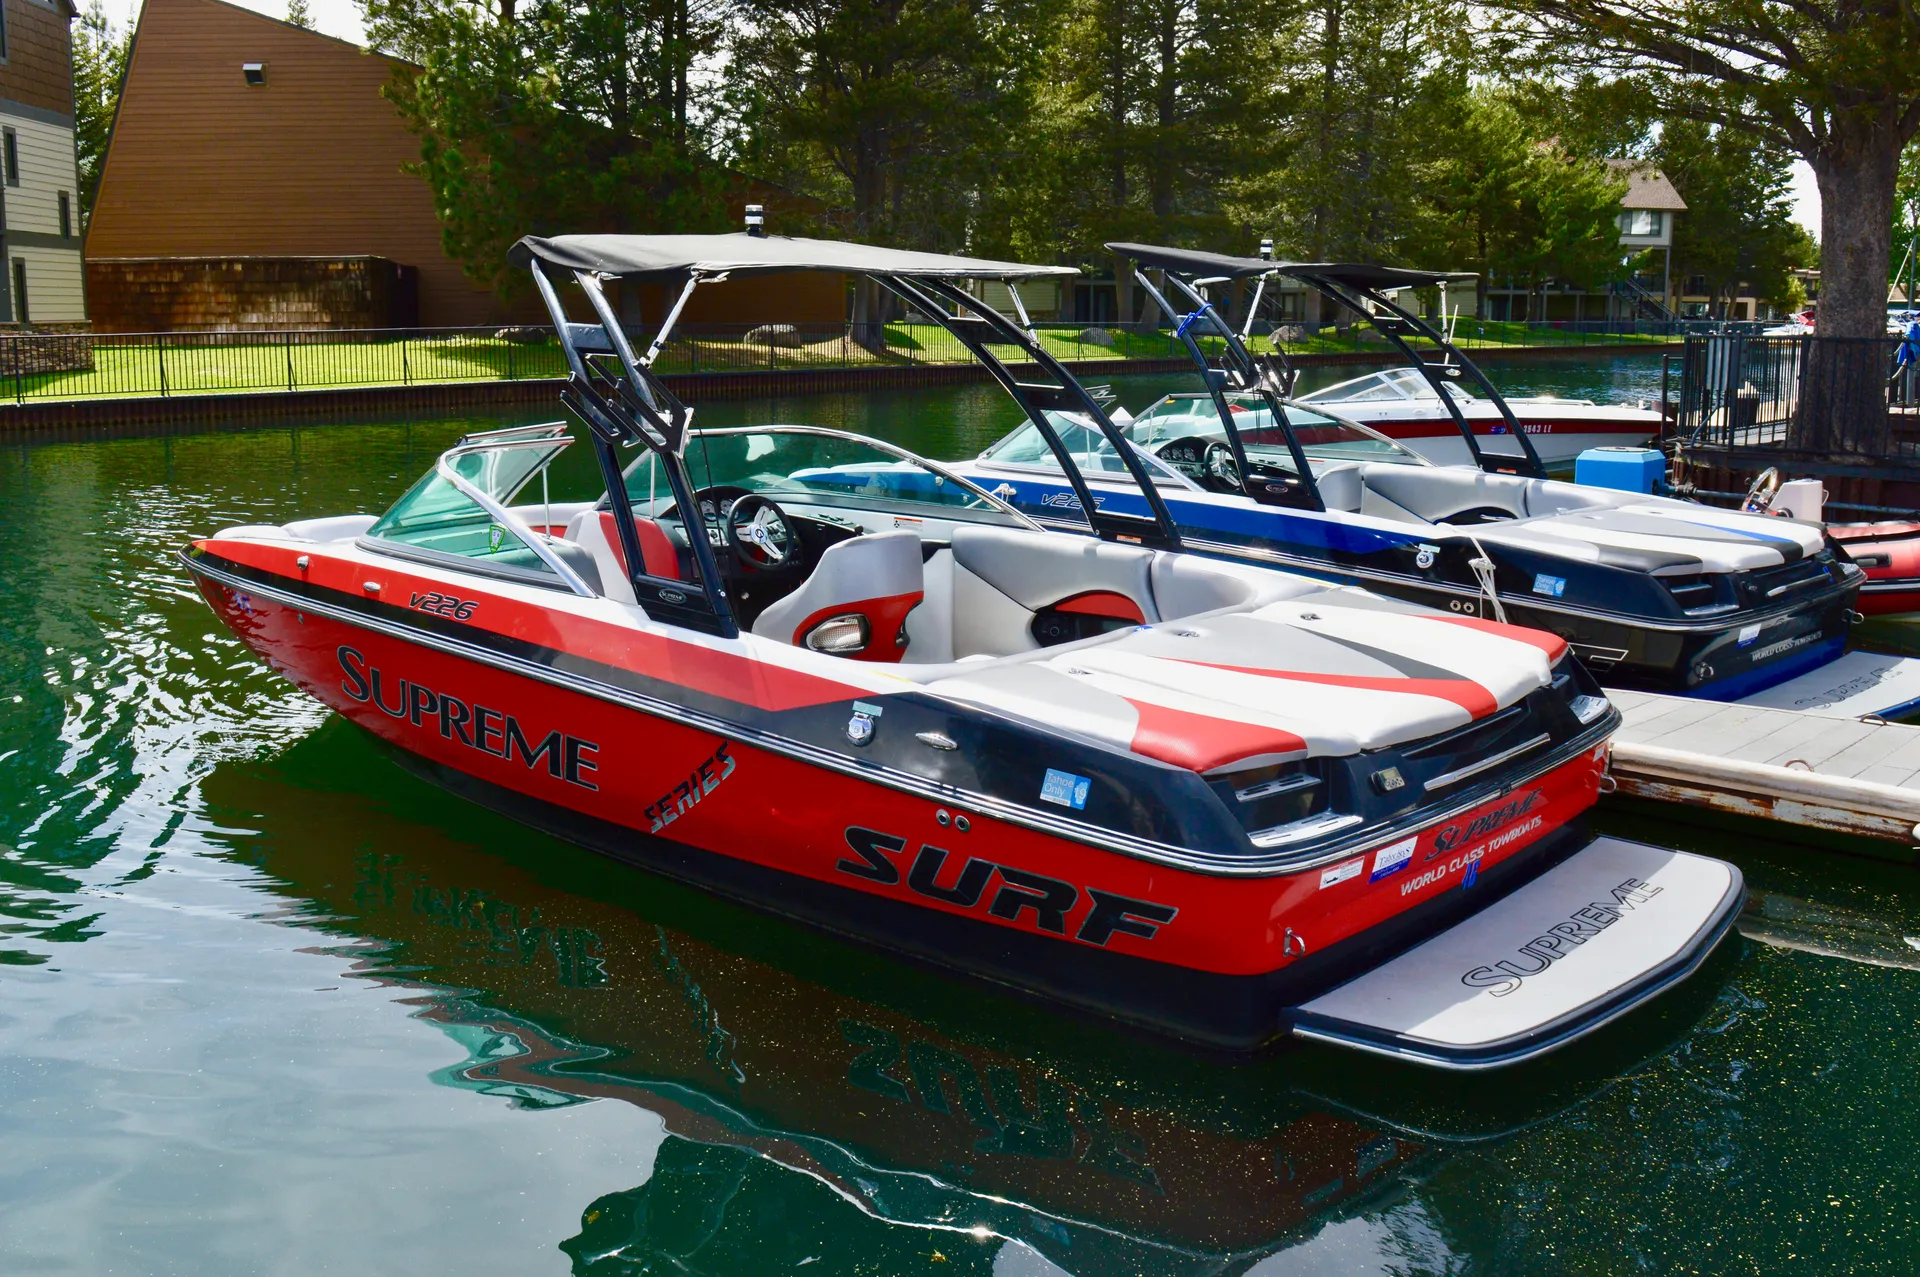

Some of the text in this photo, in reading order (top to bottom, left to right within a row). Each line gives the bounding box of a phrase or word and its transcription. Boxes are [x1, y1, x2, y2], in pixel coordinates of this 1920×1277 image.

[337, 645, 599, 792] SUPREME
[644, 740, 736, 834] SERIES
[1044, 782, 1065, 798] Only
[1047, 772, 1074, 788] Tahoe
[1074, 786, 1087, 800] 19
[1401, 865, 1446, 896] WORLD
[1449, 845, 1485, 873] CLASS
[1488, 815, 1542, 852] TOWBOATS
[1424, 786, 1543, 862] SUPREME
[835, 825, 1180, 947] SURF
[1461, 878, 1664, 998] SUPREME
